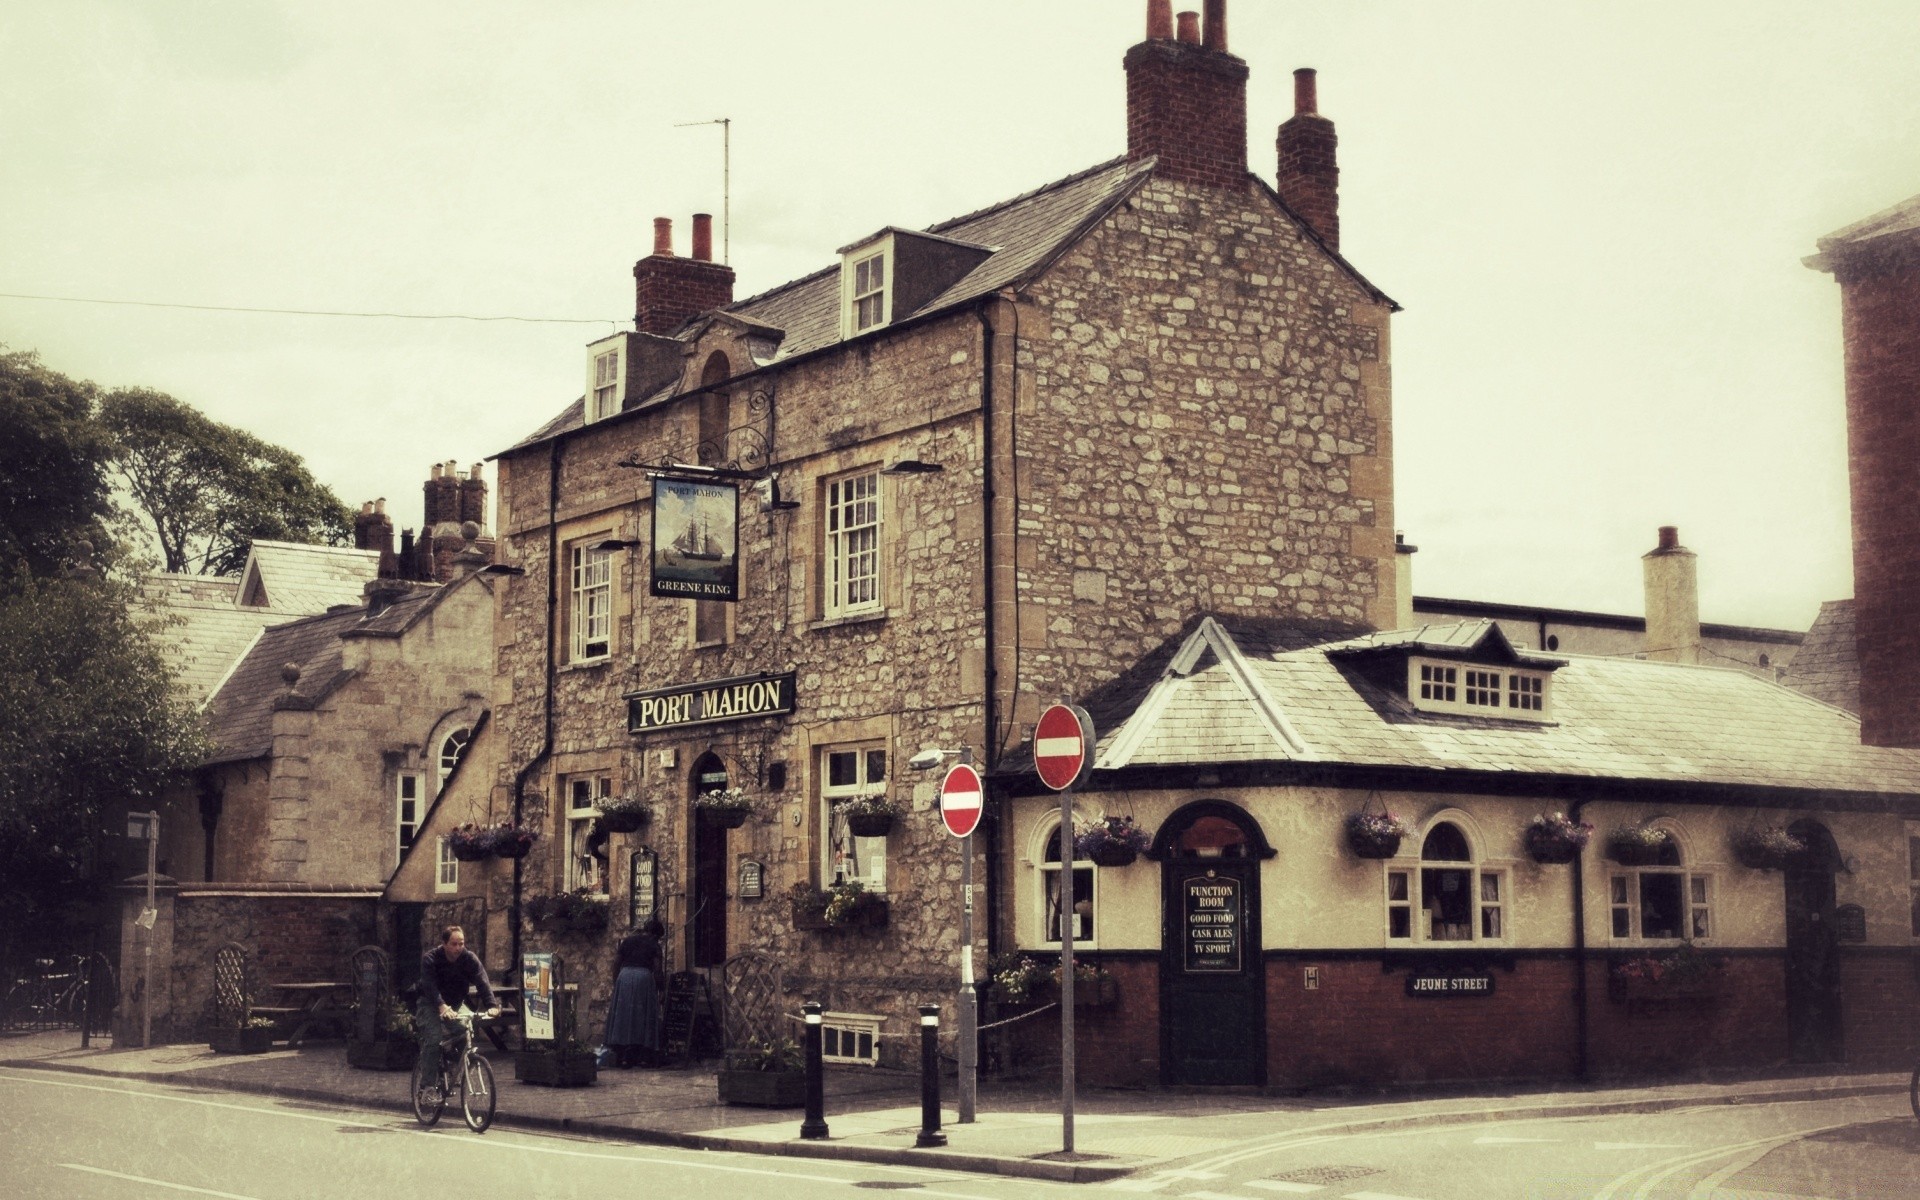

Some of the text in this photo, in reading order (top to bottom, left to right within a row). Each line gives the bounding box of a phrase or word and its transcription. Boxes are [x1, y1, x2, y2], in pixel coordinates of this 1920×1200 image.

[668, 486, 724, 499] PORT MAHON
[657, 580, 731, 595] GREENE KING
[640, 680, 782, 726] PORT MAHON
[637, 862, 652, 873] GOOD
[637, 875, 652, 887] FOOD
[1190, 886, 1233, 896] FUNCTION
[1199, 897, 1224, 907] ROOM
[1190, 914, 1234, 923] GOOD FOOD
[1192, 929, 1233, 938] CASK ALES
[1194, 944, 1231, 954] TV SPORT
[1414, 978, 1489, 990] JEUNE STREET
